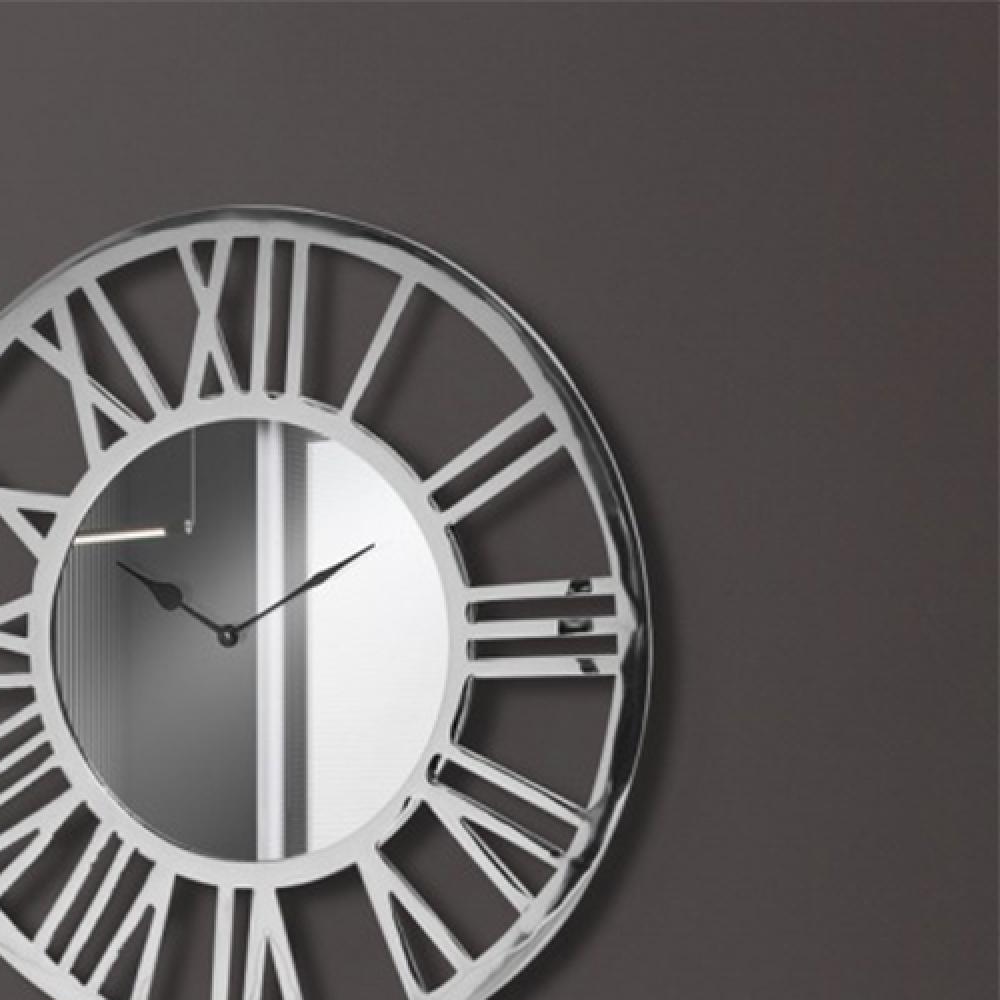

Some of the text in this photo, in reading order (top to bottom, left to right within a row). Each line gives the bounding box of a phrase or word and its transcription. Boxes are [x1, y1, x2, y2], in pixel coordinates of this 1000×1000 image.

[178, 236, 311, 400] XII
[425, 394, 573, 525] II
[467, 576, 619, 679] III
[420, 741, 595, 913] IV
